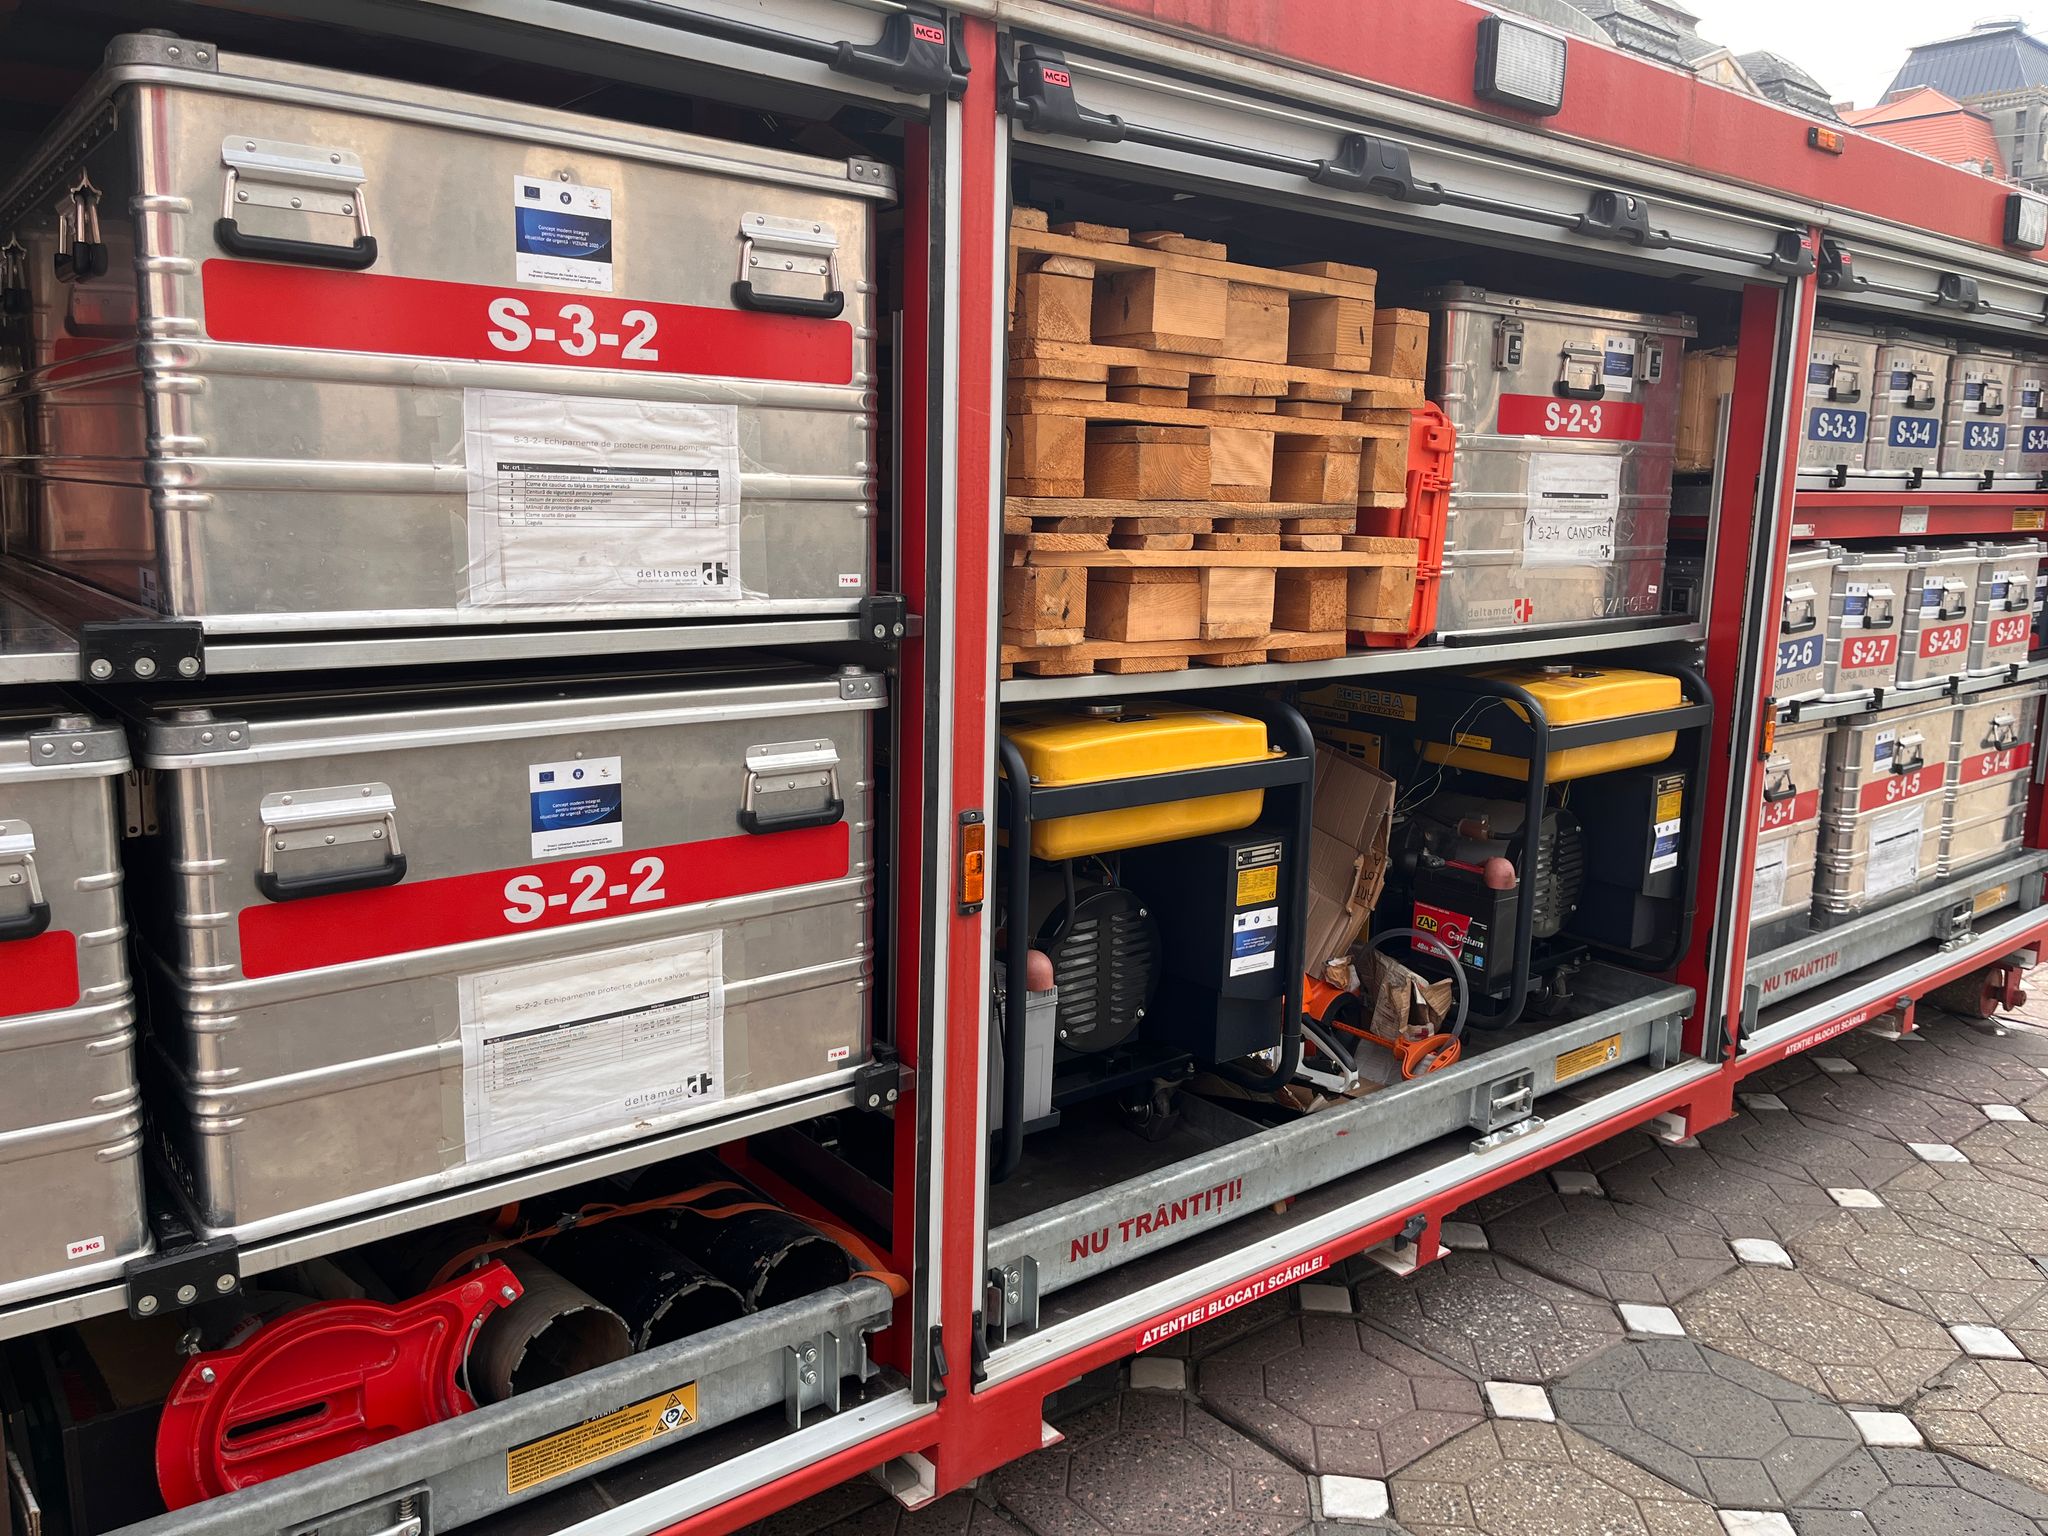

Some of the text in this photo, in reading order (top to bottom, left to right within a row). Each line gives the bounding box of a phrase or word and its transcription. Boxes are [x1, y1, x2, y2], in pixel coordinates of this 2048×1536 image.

[915, 26, 942, 40] MCD
[1045, 71, 1068, 84] MCD
[487, 297, 659, 362] S-3-2
[1545, 402, 1602, 433] S-2-3
[1817, 412, 1856, 438] S-3-3
[1897, 420, 1930, 444] S-3-4
[1970, 425, 2000, 447] S-3-5
[2028, 430, 2048, 450] S-3-
[545, 437, 598, 447] Echipamente
[651, 443, 677, 451] pentru
[637, 569, 697, 578] deltamed
[1468, 606, 1512, 618] deltamed
[1928, 628, 1962, 653] S-2-8
[1996, 619, 2024, 643] S-2-9
[1852, 639, 1889, 665] S-2-7
[1359, 704, 1406, 718] GENERATOR
[1981, 750, 2010, 776] S-1-4
[1886, 773, 1920, 801] S-1-5
[503, 856, 666, 924] S-2-2
[1417, 916, 1437, 929] ZAP
[1448, 931, 1484, 949] Calcium
[545, 989, 596, 1006] Echipamente
[665, 972, 690, 982] salvare
[1763, 974, 1781, 994] NU
[625, 1084, 683, 1107] deltamed
[1070, 1178, 1242, 1263] NU TRÂNTIȚI!
[72, 1242, 100, 1254] 99 KG
[1141, 1256, 1323, 1347] ATENȚIE! BLOCAȚI SCĂRILE!
